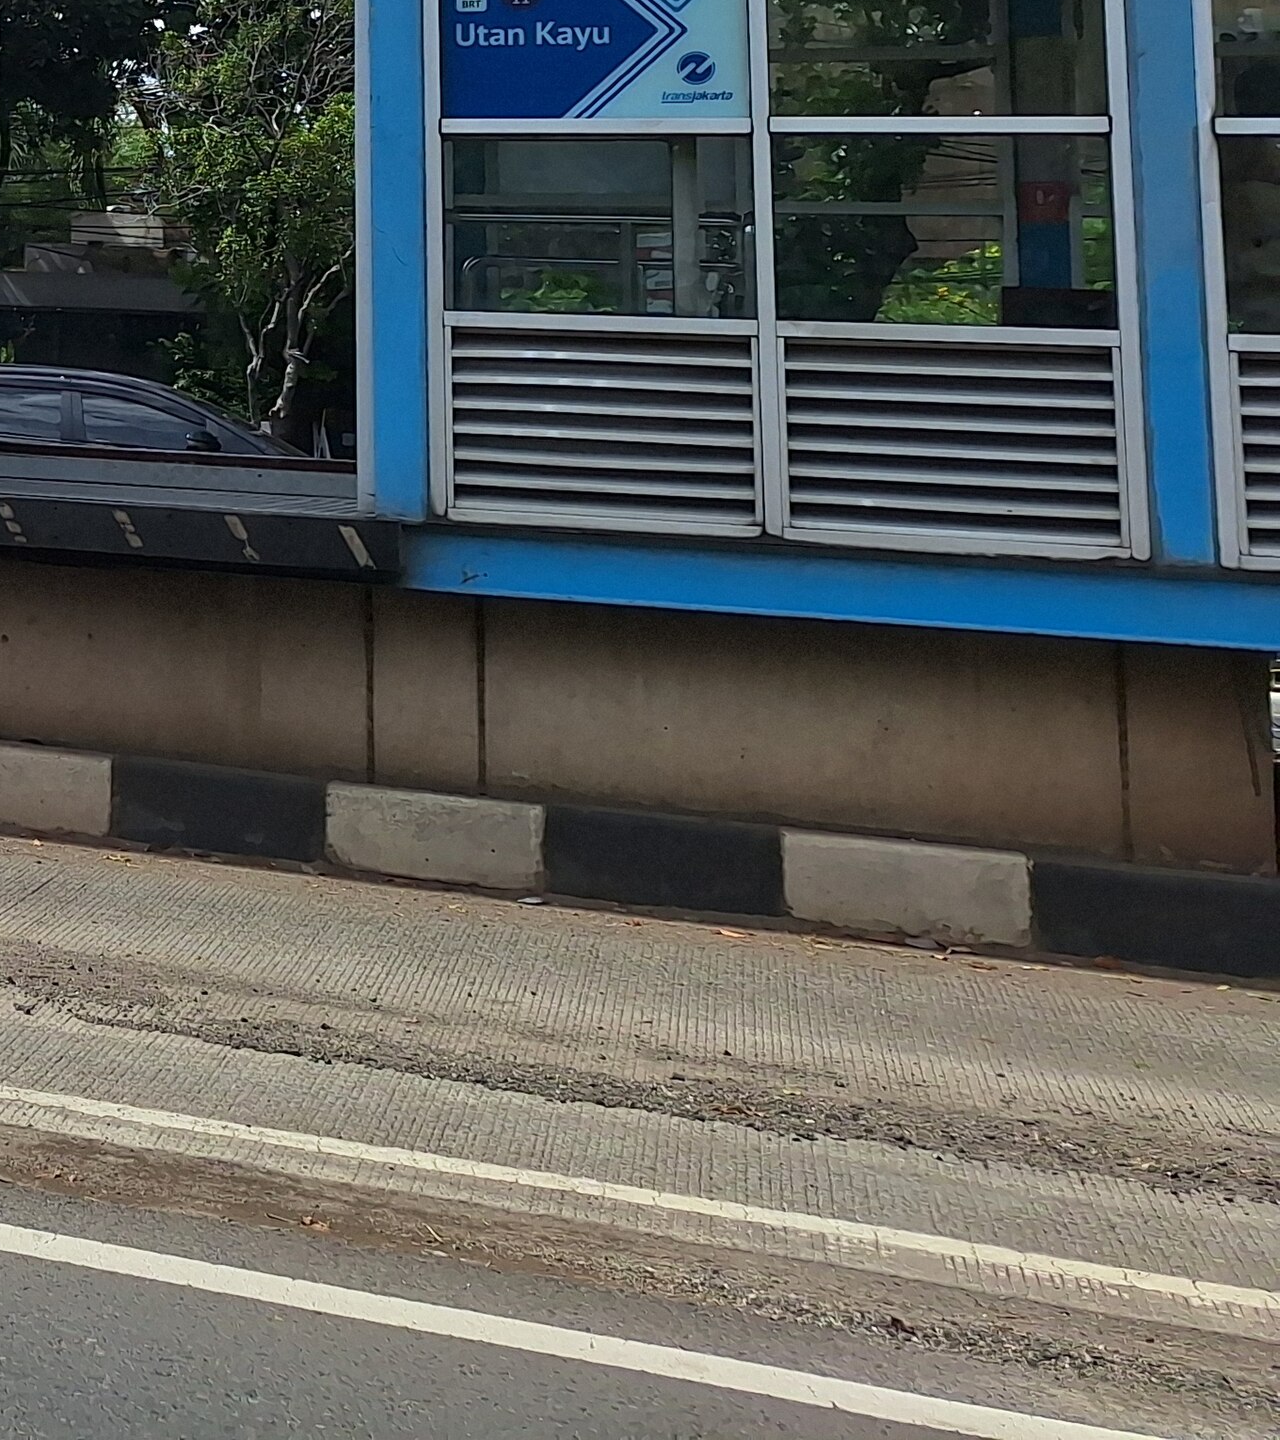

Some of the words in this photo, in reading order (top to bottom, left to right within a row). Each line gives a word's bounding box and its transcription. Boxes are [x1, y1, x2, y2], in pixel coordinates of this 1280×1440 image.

[462, 0, 482, 9] BRT
[455, 23, 525, 47] Utan
[536, 21, 610, 50] Kayu
[661, 91, 733, 103] transjakarta
